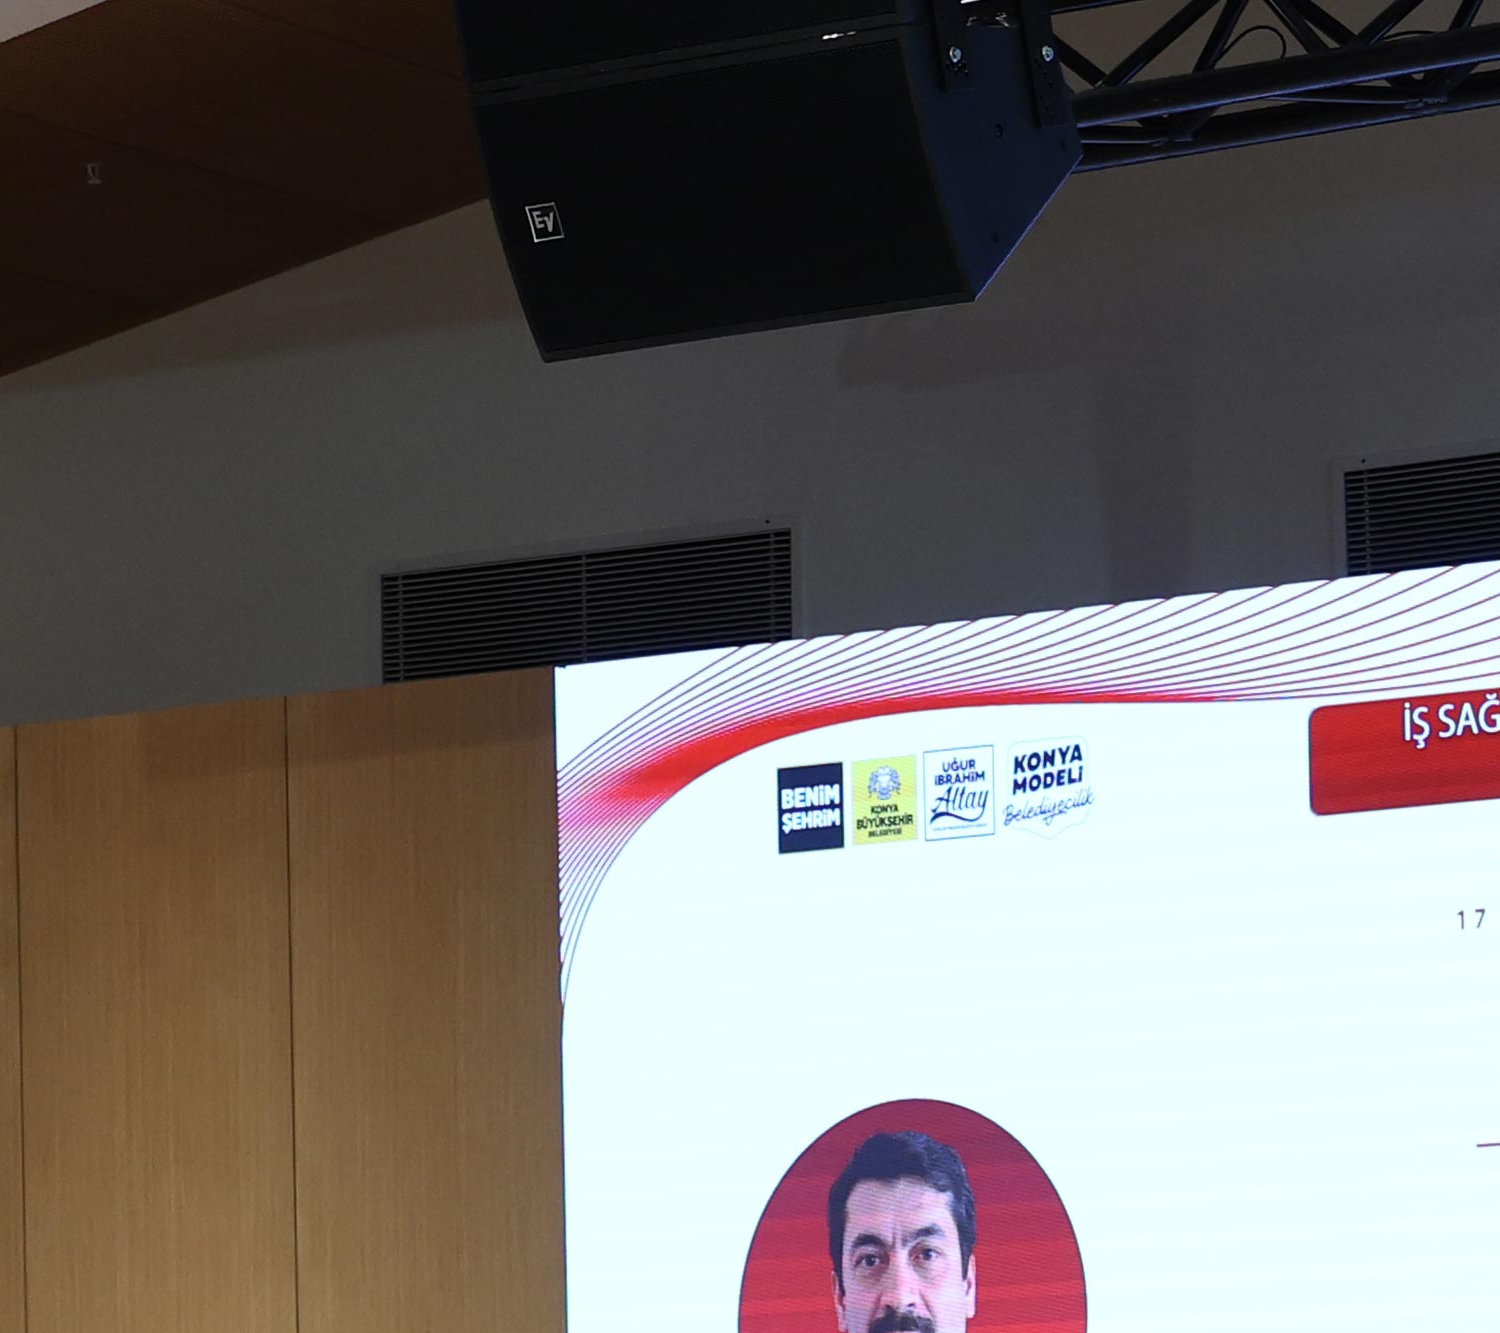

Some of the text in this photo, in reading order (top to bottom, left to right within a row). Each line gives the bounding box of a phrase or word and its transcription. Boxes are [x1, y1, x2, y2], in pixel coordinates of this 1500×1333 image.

[532, 210, 554, 233] EV
[1405, 703, 1429, 748] İŞ
[943, 757, 976, 772] UĞUR
[1014, 744, 1083, 774] KONYA
[935, 771, 985, 785] İBRAHİM
[1013, 766, 1083, 795] MODELİ
[781, 784, 840, 809] BENİM
[871, 804, 899, 814] KONYA
[930, 786, 989, 824] Altay
[1003, 785, 1095, 826] Belediyecilik
[782, 808, 840, 834] ŞEHRİM
[1458, 909, 1485, 930] 17
